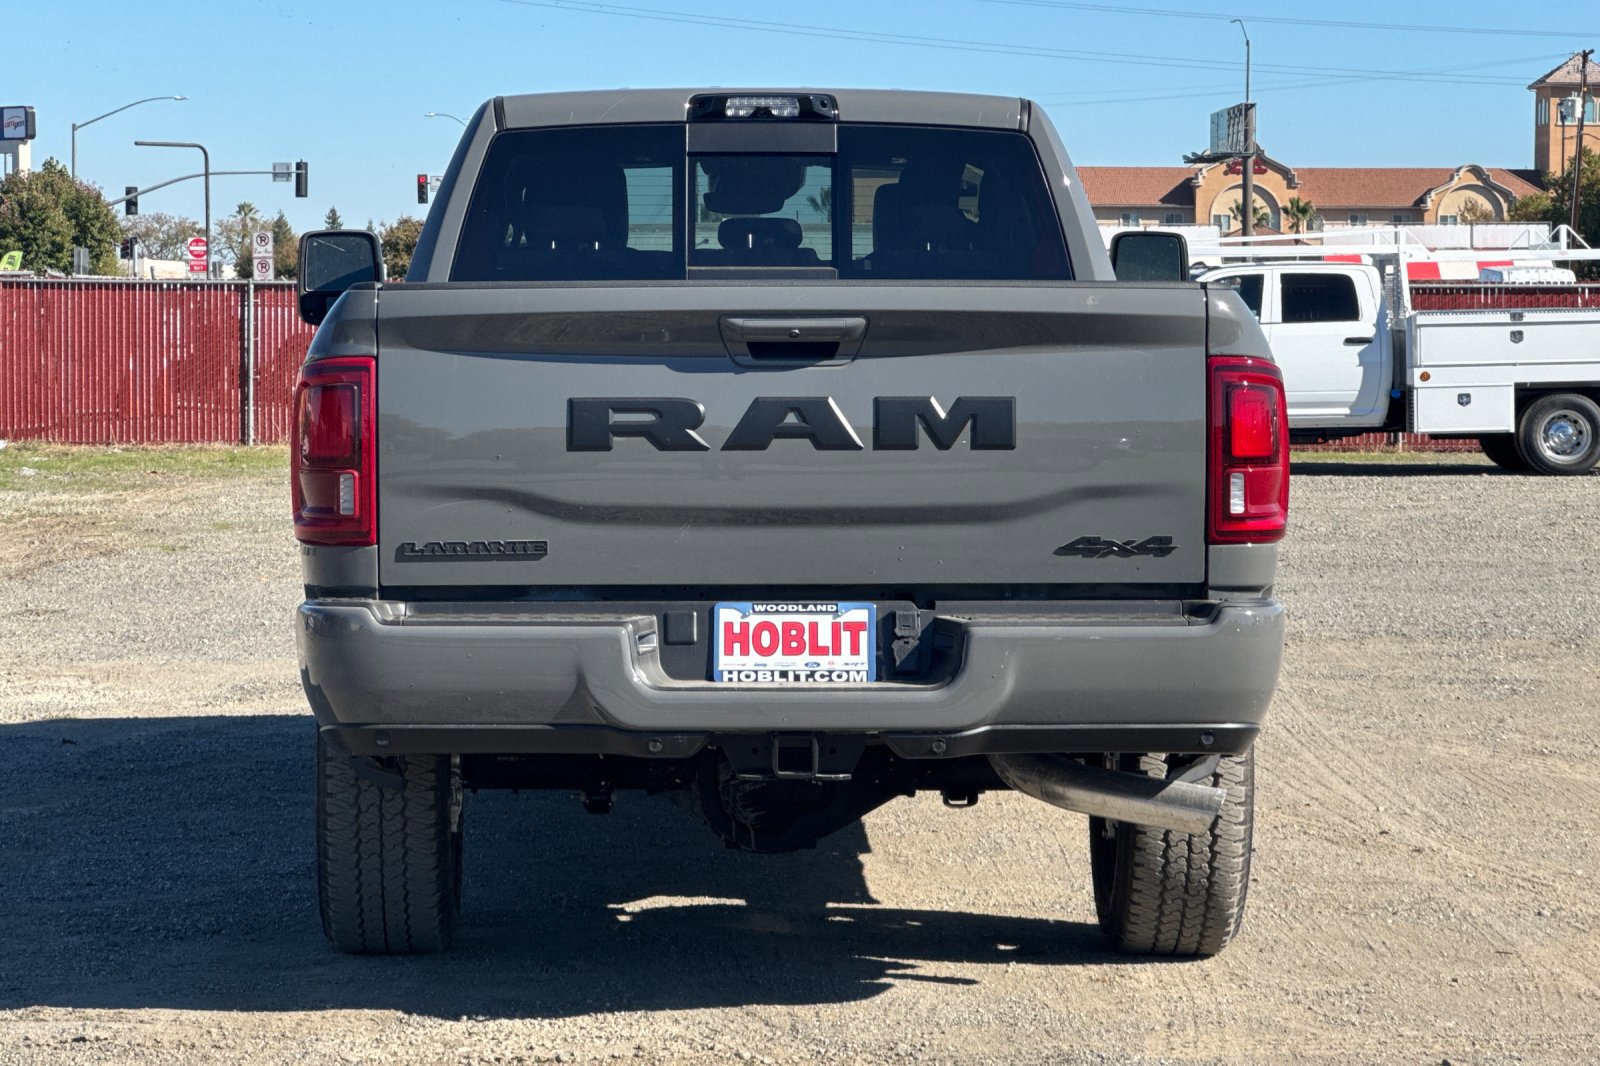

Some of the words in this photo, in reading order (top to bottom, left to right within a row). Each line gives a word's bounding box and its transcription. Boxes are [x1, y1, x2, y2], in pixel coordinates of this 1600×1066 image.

[566, 396, 1017, 452] RAM
[395, 540, 549, 562] LARAMIE
[753, 604, 837, 612] WOODLAND
[723, 621, 867, 657] HOBLIT
[722, 670, 867, 682] HOBLIT.COM
